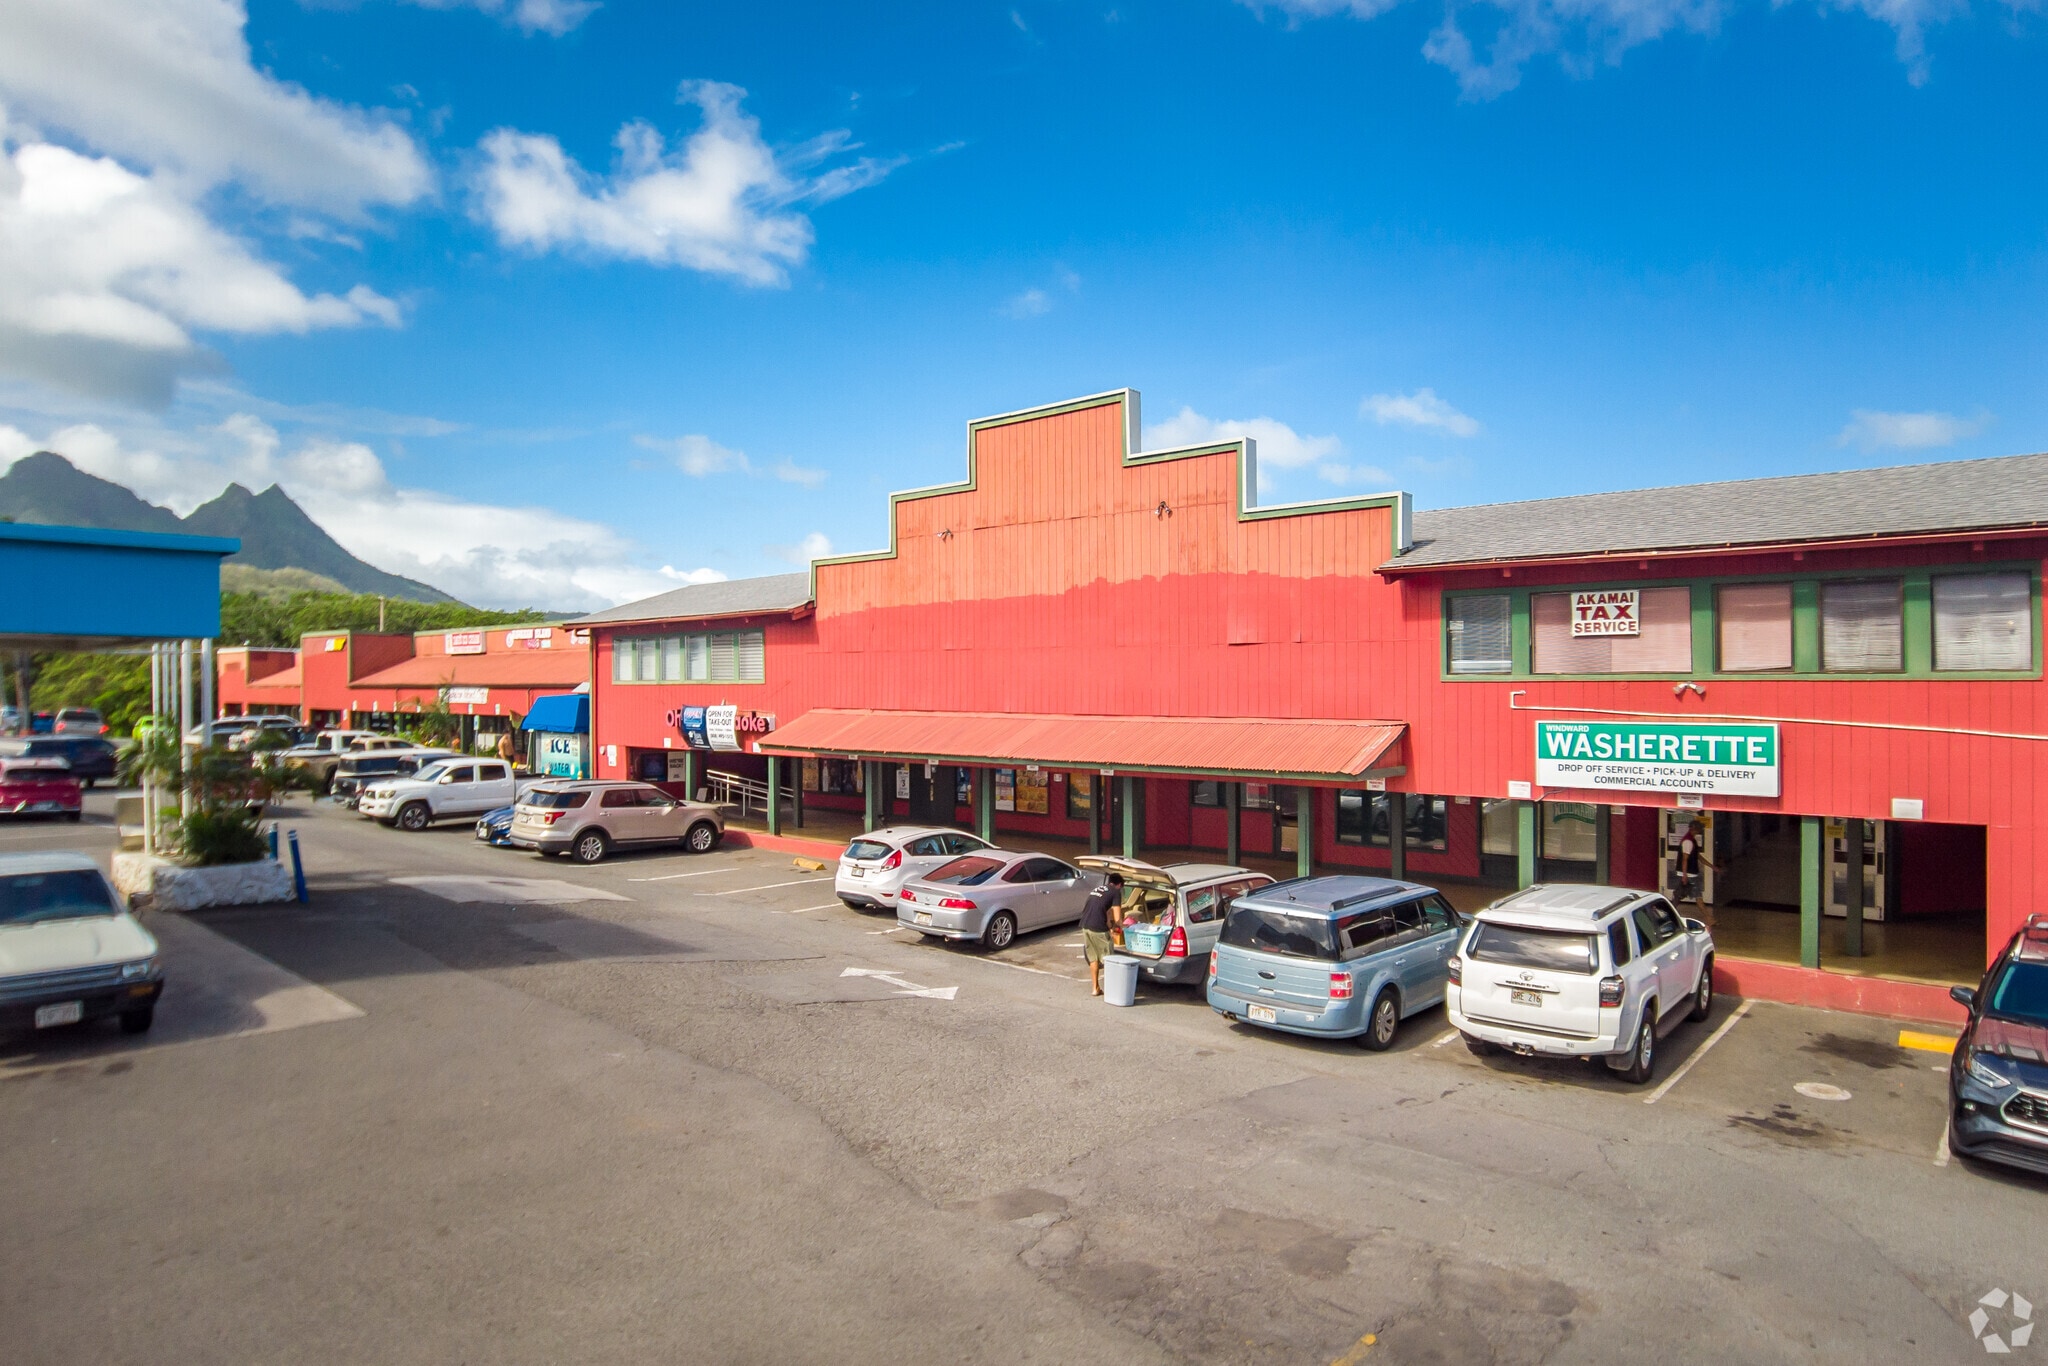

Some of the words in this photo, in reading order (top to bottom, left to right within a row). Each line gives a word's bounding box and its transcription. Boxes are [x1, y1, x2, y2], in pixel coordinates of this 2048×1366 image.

[1576, 592, 1634, 605] AKAMAI
[1576, 605, 1633, 621] TAX
[1574, 621, 1637, 633] SERVICE
[708, 710, 721, 718] OPEN
[722, 710, 733, 718] FOR
[708, 718, 732, 726] TAKE-OUT
[1546, 724, 1590, 733] WINDWARD
[550, 738, 571, 755] ICE
[1546, 733, 1767, 763] WASHERETTE
[1557, 763, 1583, 772] DROP
[1585, 765, 1603, 774] OFF
[1605, 765, 1645, 775] SERVICE
[1653, 767, 1694, 777] PICK-UP
[1697, 769, 1704, 778] &
[1707, 769, 1757, 780] DELIVERY
[1594, 775, 1657, 787] COMMERCIAL
[1659, 778, 1715, 789] ACCOUNTS
